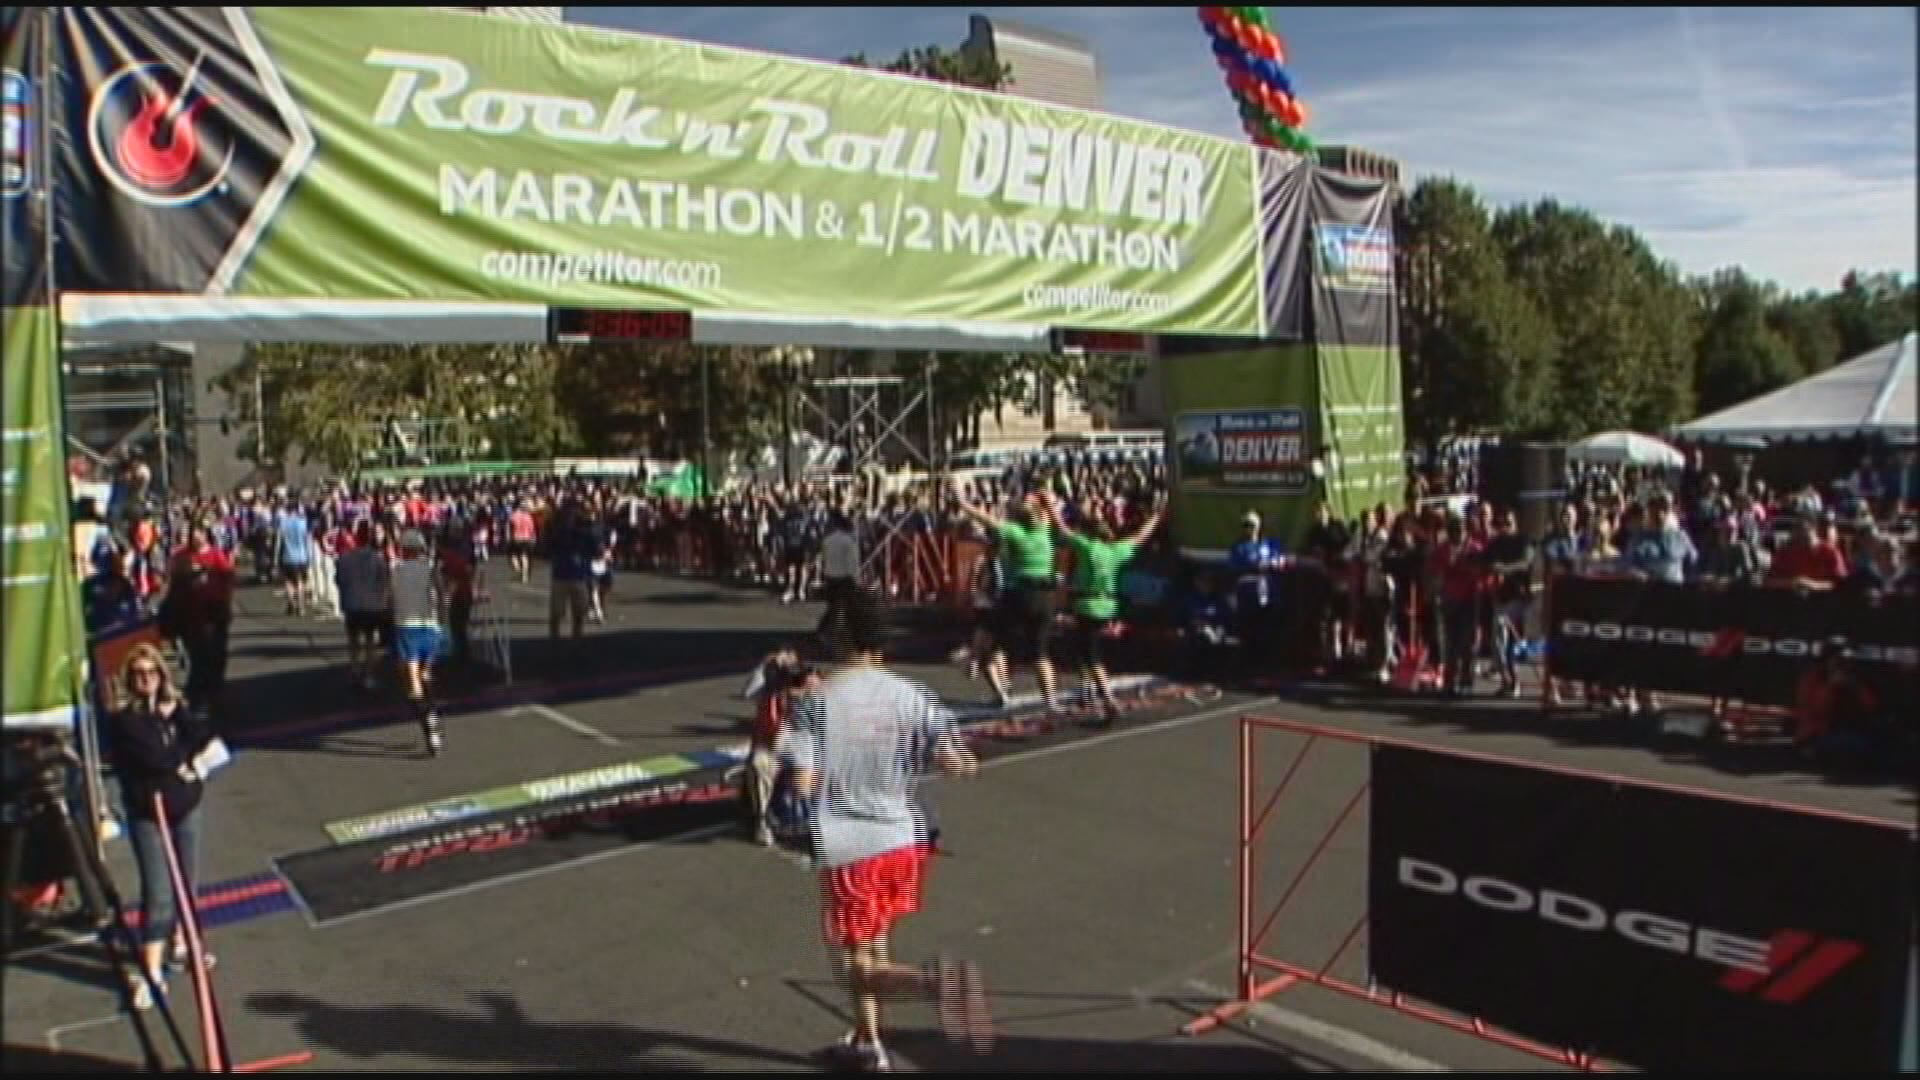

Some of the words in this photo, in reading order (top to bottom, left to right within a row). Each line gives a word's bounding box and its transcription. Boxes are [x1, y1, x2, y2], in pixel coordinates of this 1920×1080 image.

[364, 47, 667, 148] Rock
[748, 97, 939, 181] Roll
[956, 115, 1207, 226] DENVER
[438, 162, 805, 240] MARATHON
[815, 200, 844, 240] &
[855, 190, 934, 257] 1/2
[942, 210, 1181, 273] MARATHON
[480, 249, 721, 289] competitor.com
[1222, 435, 1301, 464] DENVER
[1561, 618, 1718, 648] DODGE
[1743, 634, 1917, 663] DOGE
[1397, 856, 1773, 976] DODGE
